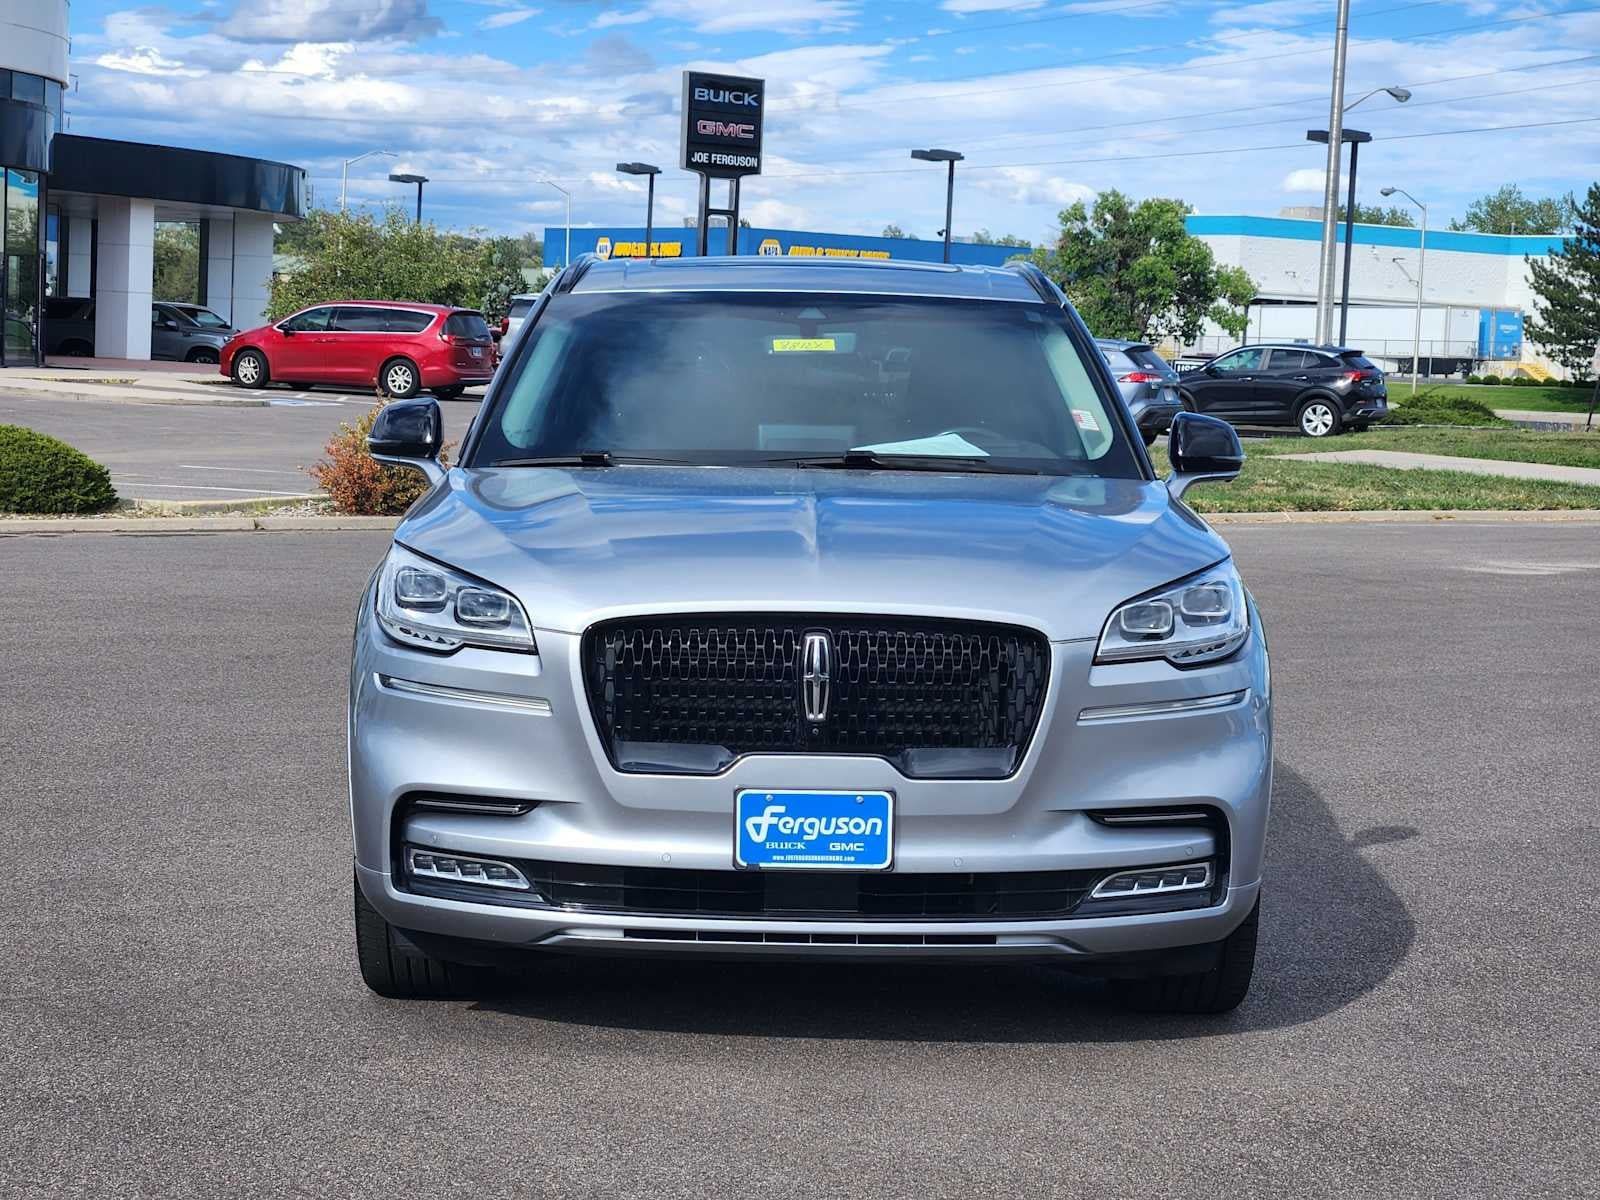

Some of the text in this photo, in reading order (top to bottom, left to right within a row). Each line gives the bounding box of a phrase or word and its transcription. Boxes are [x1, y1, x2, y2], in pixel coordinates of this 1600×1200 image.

[694, 87, 759, 106] BUICK
[697, 119, 755, 139] GMC
[691, 152, 758, 168] JOE FERGUSON
[745, 805, 883, 843] Ferguson
[765, 841, 865, 851] BUICK GMC
